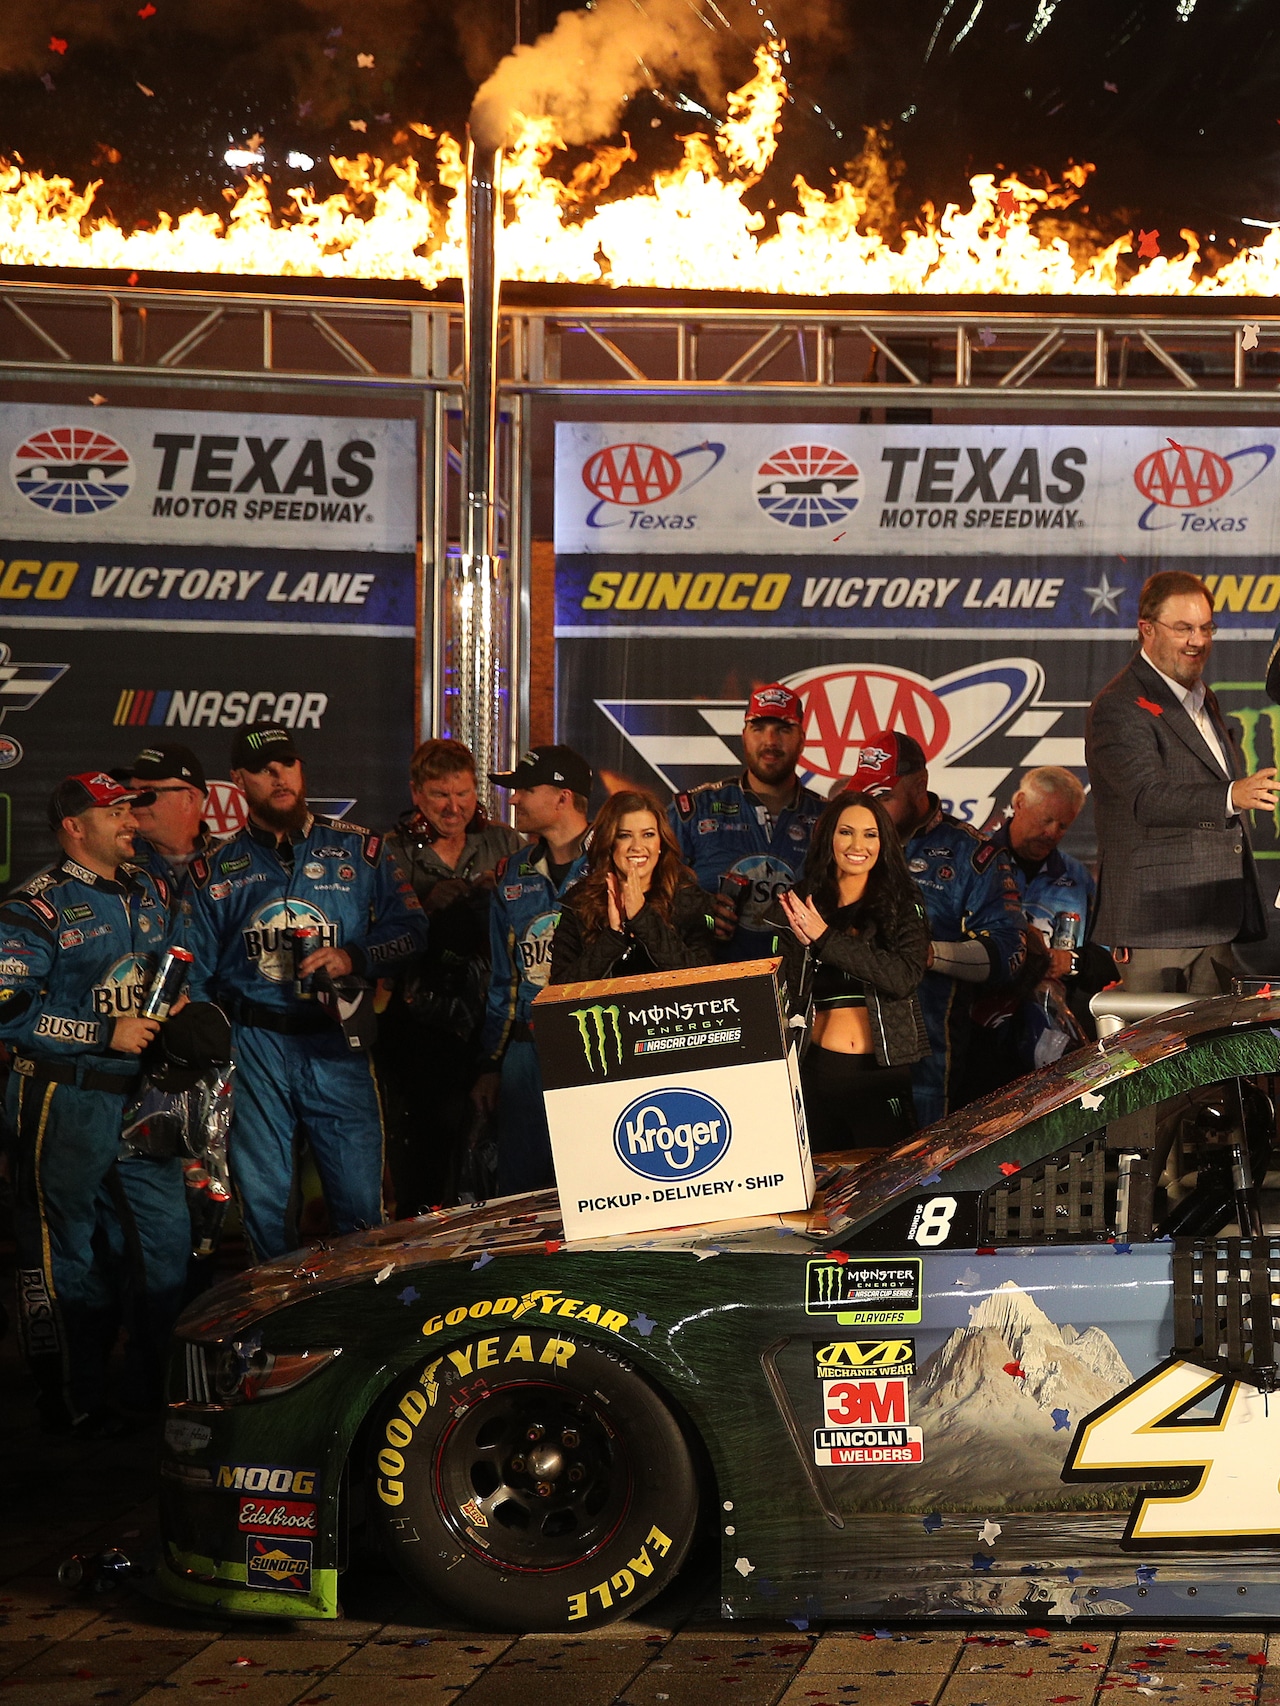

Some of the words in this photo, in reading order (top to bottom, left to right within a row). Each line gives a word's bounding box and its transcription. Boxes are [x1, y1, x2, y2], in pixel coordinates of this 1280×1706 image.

[152, 433, 376, 498] TEXAS
[588, 444, 677, 504] AAA
[881, 447, 1087, 504] TEXAS
[1140, 446, 1227, 507] AAA
[152, 497, 236, 520] MOTOR
[243, 499, 364, 522] SPEEDWAY
[629, 510, 697, 530] Texas
[880, 509, 958, 529] MOTOR
[963, 509, 1078, 529] SPEEDWAY
[1180, 513, 1248, 532] Texas
[91, 564, 263, 600] VICTORY
[266, 573, 375, 604] LANE
[581, 571, 791, 611] SUNOCO
[801, 577, 959, 609] VICTORY
[963, 577, 1065, 609] LANE
[165, 690, 328, 729] NASCAR
[202, 784, 247, 835] AA
[62, 860, 97, 885] BUSCH
[244, 925, 336, 959] BUSH
[367, 933, 416, 962] BUSCH
[520, 940, 553, 968] BUS
[93, 984, 145, 1015] BUS
[628, 998, 740, 1026] MONSTER
[35, 1015, 98, 1042] BUSCH
[647, 1018, 725, 1035] ENERGY
[646, 1036, 686, 1052] NASCAR
[686, 1032, 708, 1048] CUP
[707, 1030, 742, 1045] SERIES
[626, 1105, 721, 1170] Kroger
[577, 1192, 642, 1213] PICKUP
[653, 1180, 734, 1203] DELIVERY
[745, 1173, 785, 1190] SHIP
[914, 1197, 958, 1246] 8
[916, 1203, 924, 1214] OF
[907, 1215, 920, 1240] ROUND
[847, 1269, 914, 1282] MONSTER
[855, 1289, 880, 1298] NASCAR
[880, 1289, 893, 1298] CUP
[892, 1289, 914, 1297] SERIES
[854, 1313, 905, 1323] PLAYOFFS
[817, 1366, 878, 1378] MECHANIX
[878, 1363, 913, 1376] WEAR
[827, 1381, 906, 1425] 3M
[820, 1431, 903, 1447] LINCOLN
[839, 1449, 913, 1462] WELDERS
[216, 1466, 316, 1495] MOOG
[239, 1503, 316, 1529] Edelbrock
[466, 1502, 484, 1524] AERO
[251, 1557, 307, 1574] SUNOCO
[567, 1524, 673, 1621] EAGLE
